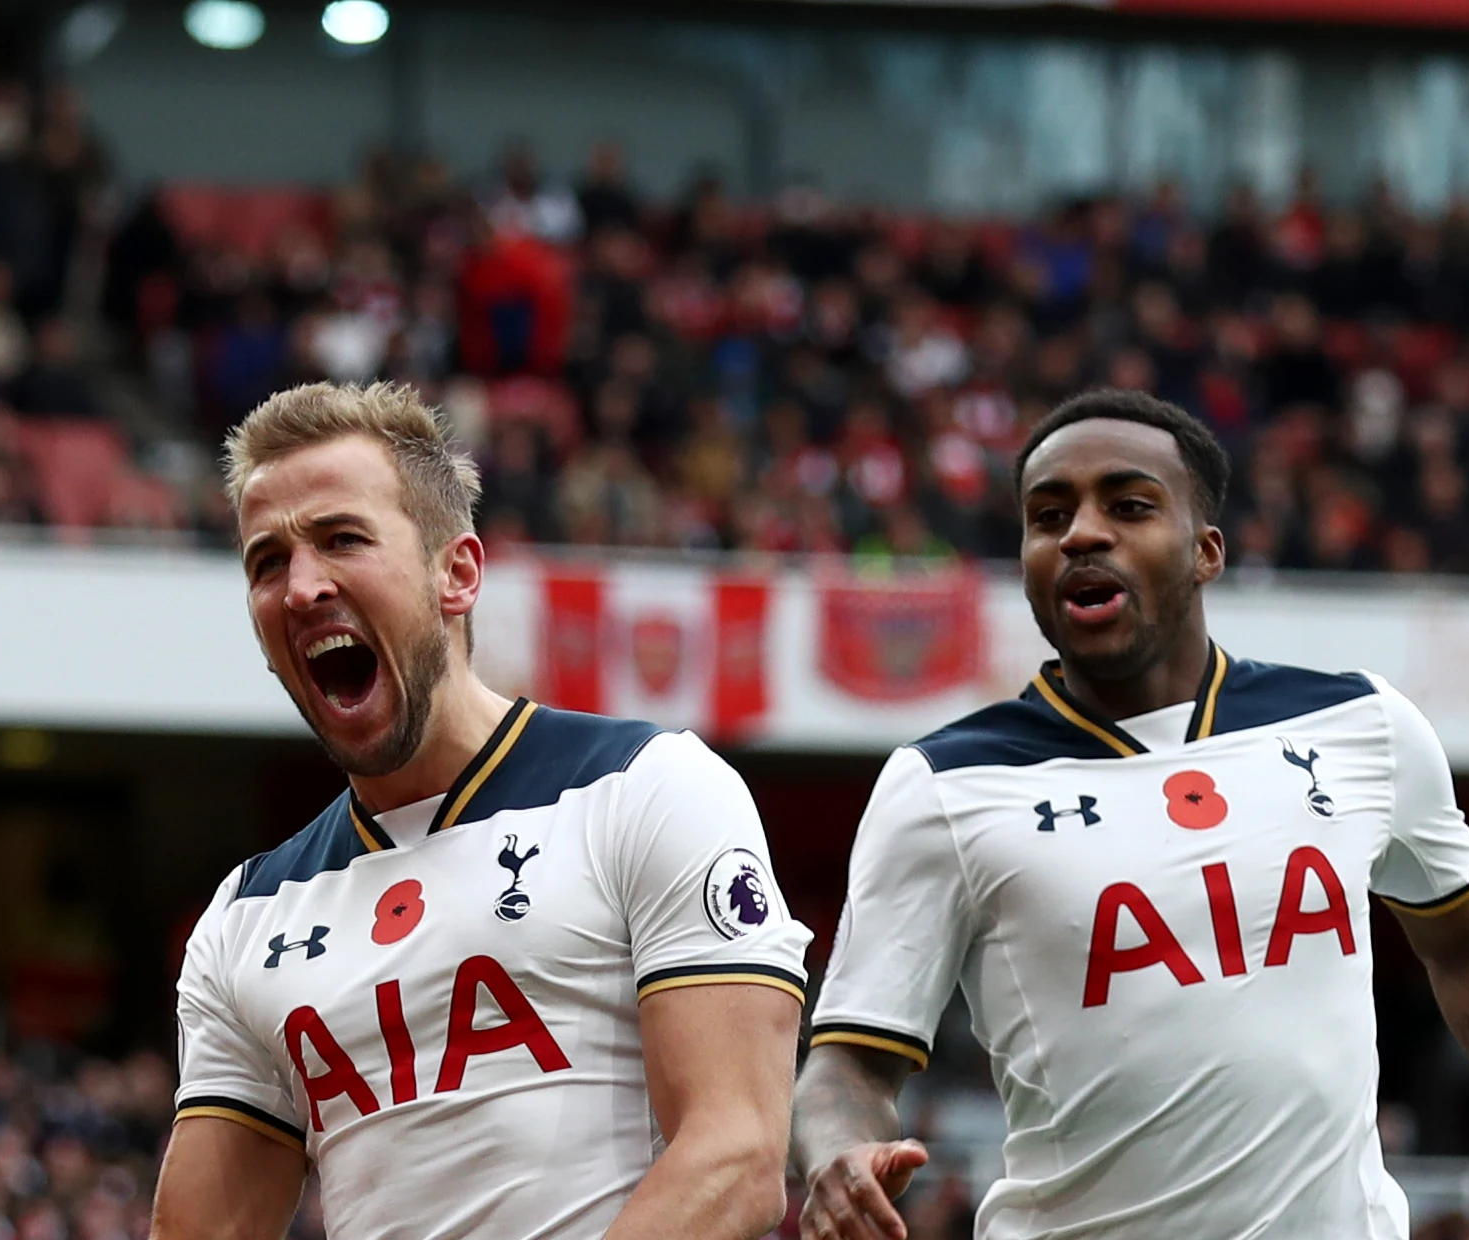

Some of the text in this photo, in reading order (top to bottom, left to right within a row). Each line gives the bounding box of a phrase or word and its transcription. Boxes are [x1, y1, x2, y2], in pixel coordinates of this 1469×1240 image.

[711, 884, 748, 938] Premier Leagu
[1082, 846, 1356, 1008] AIA
[283, 954, 572, 1132] AIA
